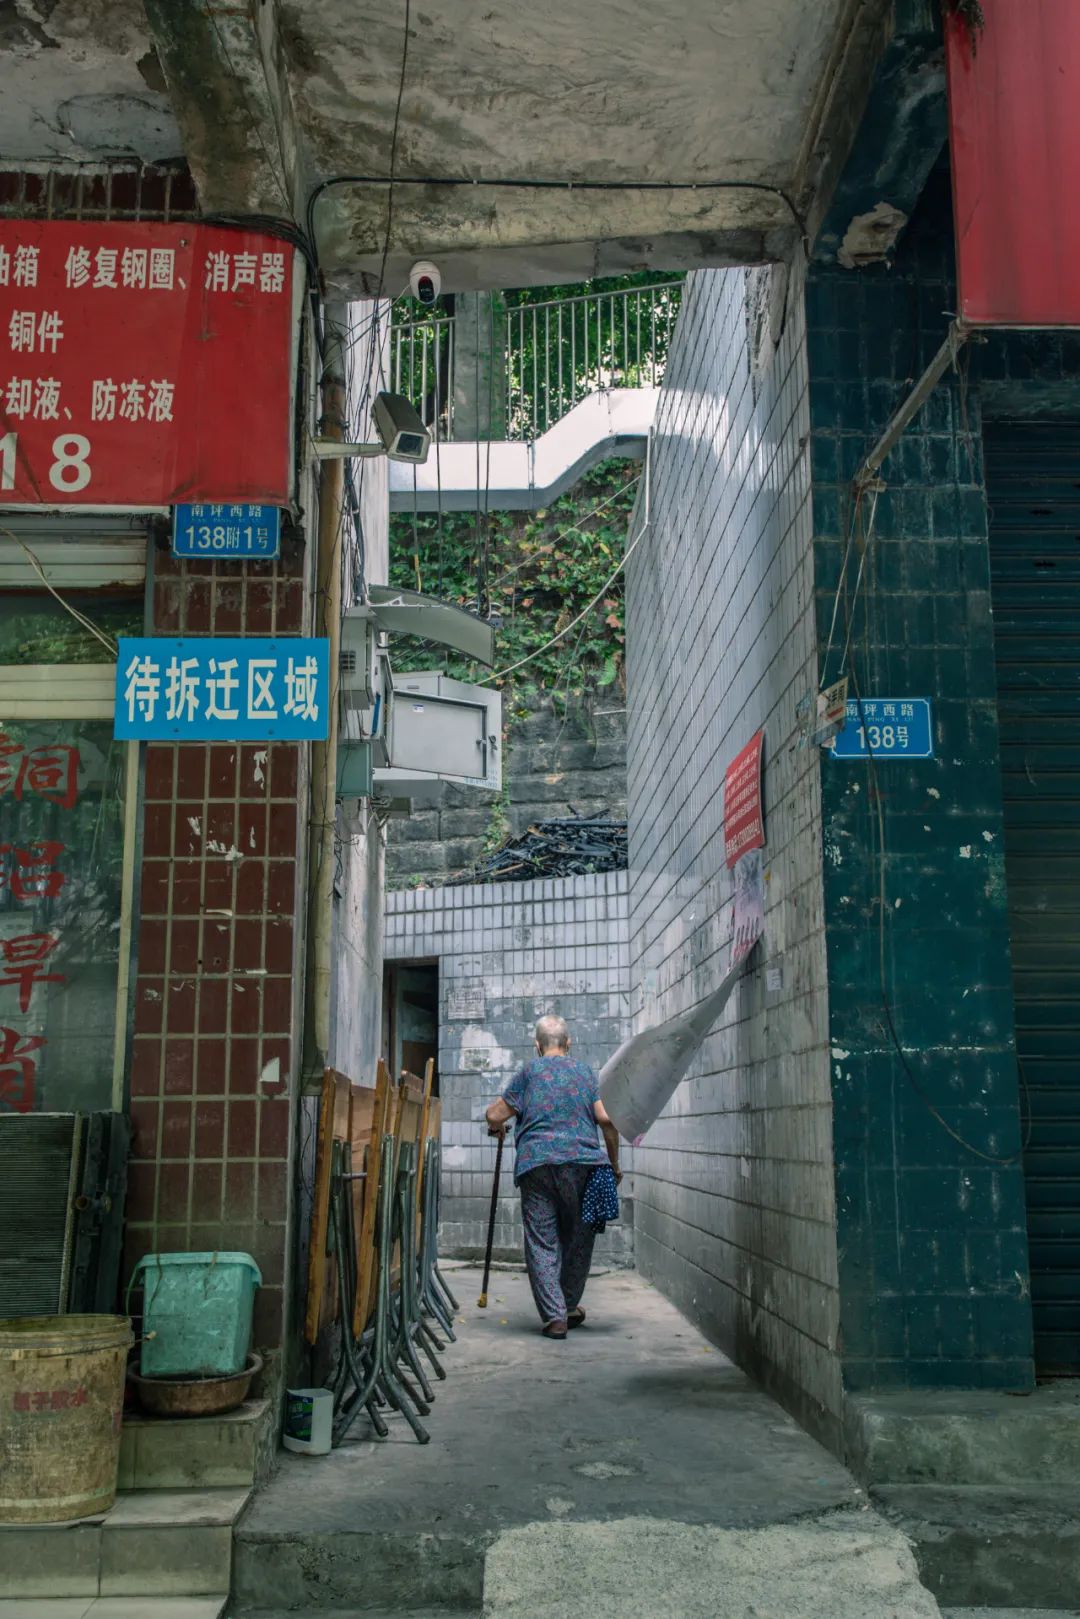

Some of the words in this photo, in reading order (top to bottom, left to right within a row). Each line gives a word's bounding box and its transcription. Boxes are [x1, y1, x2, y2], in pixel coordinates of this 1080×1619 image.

[9, 310, 64, 353] 铜件
[0, 376, 175, 422] 却液、防冻液
[191, 504, 262, 518] 南坪西路
[185, 525, 269, 550] 138附1号
[124, 655, 320, 722] 待拆迁区域
[844, 703, 914, 717] 南坪西路
[856, 725, 909, 749] 138号
